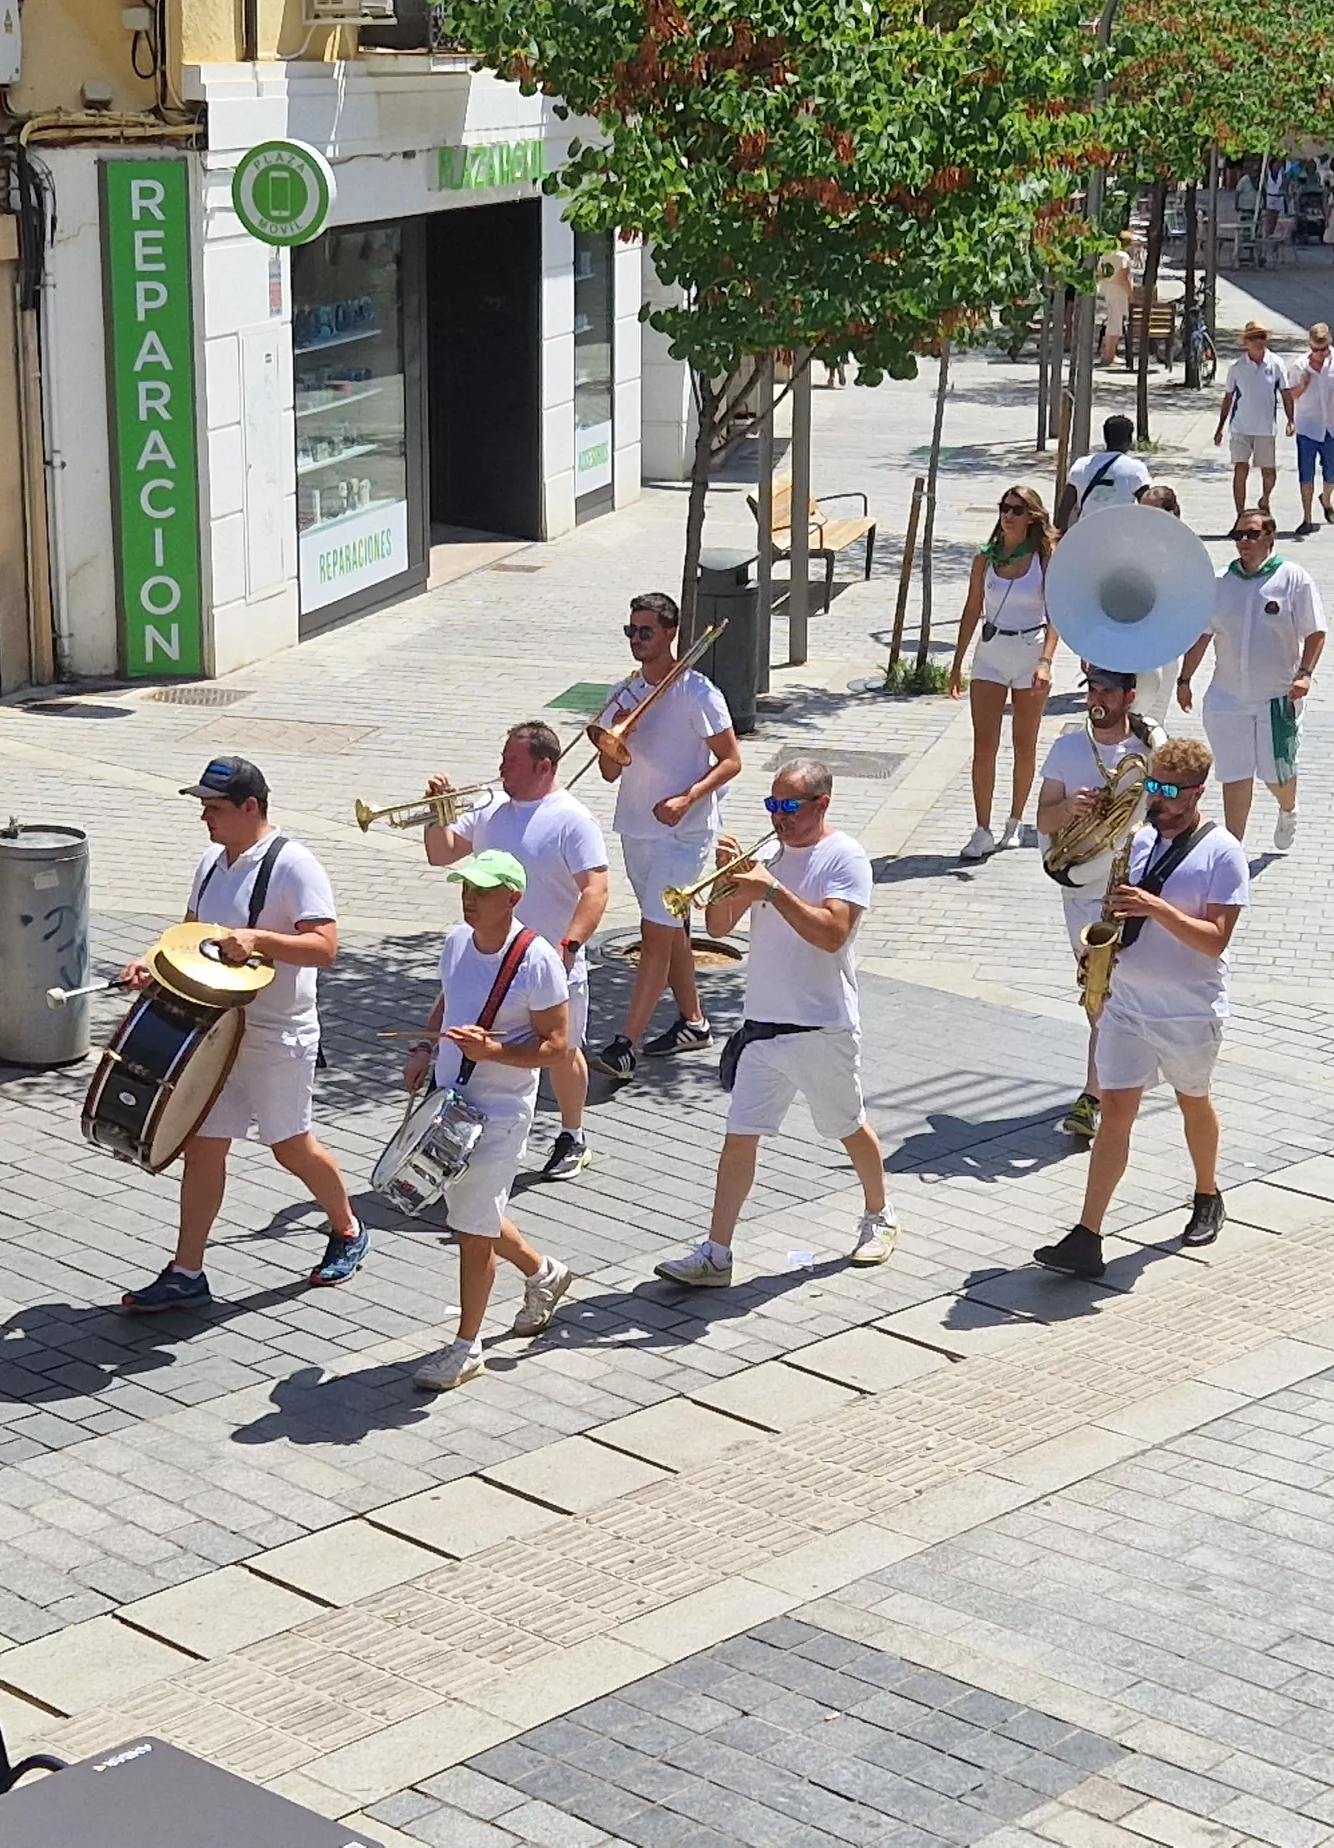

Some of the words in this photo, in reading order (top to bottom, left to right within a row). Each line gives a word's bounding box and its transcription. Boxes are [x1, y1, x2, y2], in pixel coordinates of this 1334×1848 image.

[254, 152, 306, 173] PLAZA
[438, 143, 496, 191] PLAZA
[258, 218, 303, 235] MOVIL
[130, 179, 182, 663] REPARACION
[319, 527, 392, 585] REPARACIONES
